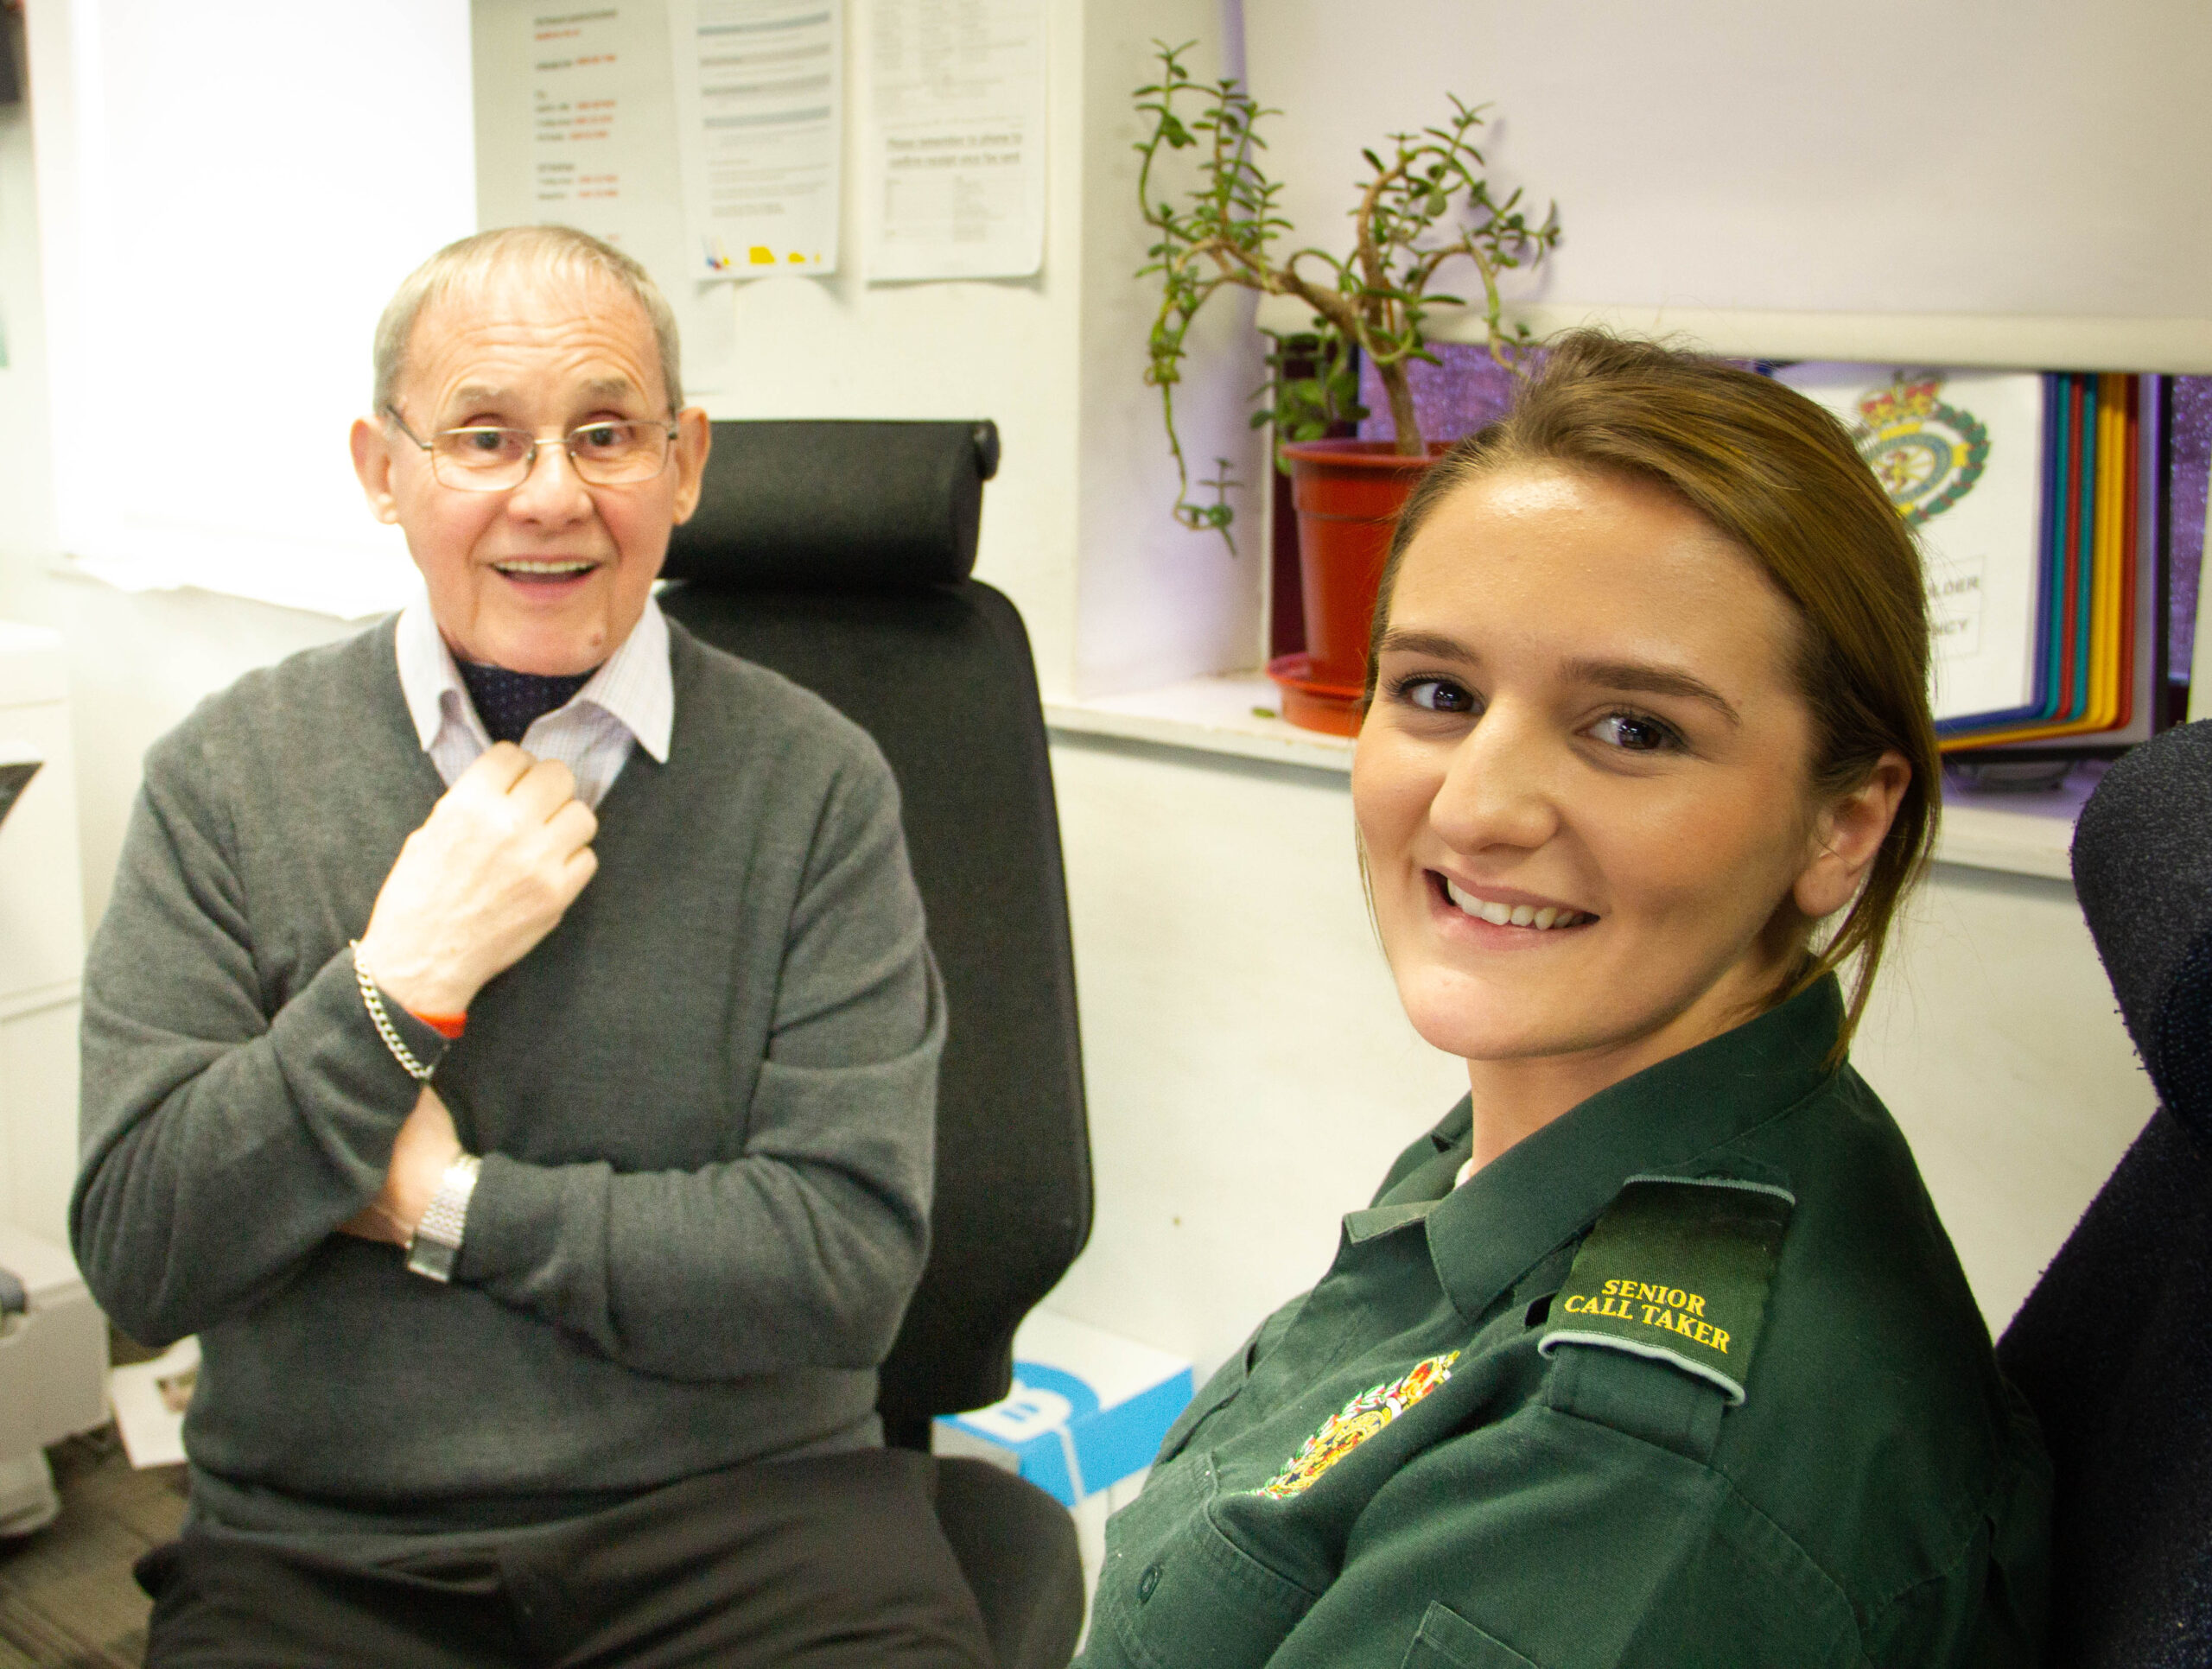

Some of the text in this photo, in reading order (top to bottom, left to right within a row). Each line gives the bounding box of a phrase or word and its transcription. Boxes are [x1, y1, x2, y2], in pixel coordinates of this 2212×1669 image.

[1927, 576, 1980, 598] LDER
[1602, 1279, 1707, 1317] SENIOR
[1564, 1295, 1731, 1355] CALL TAKER
